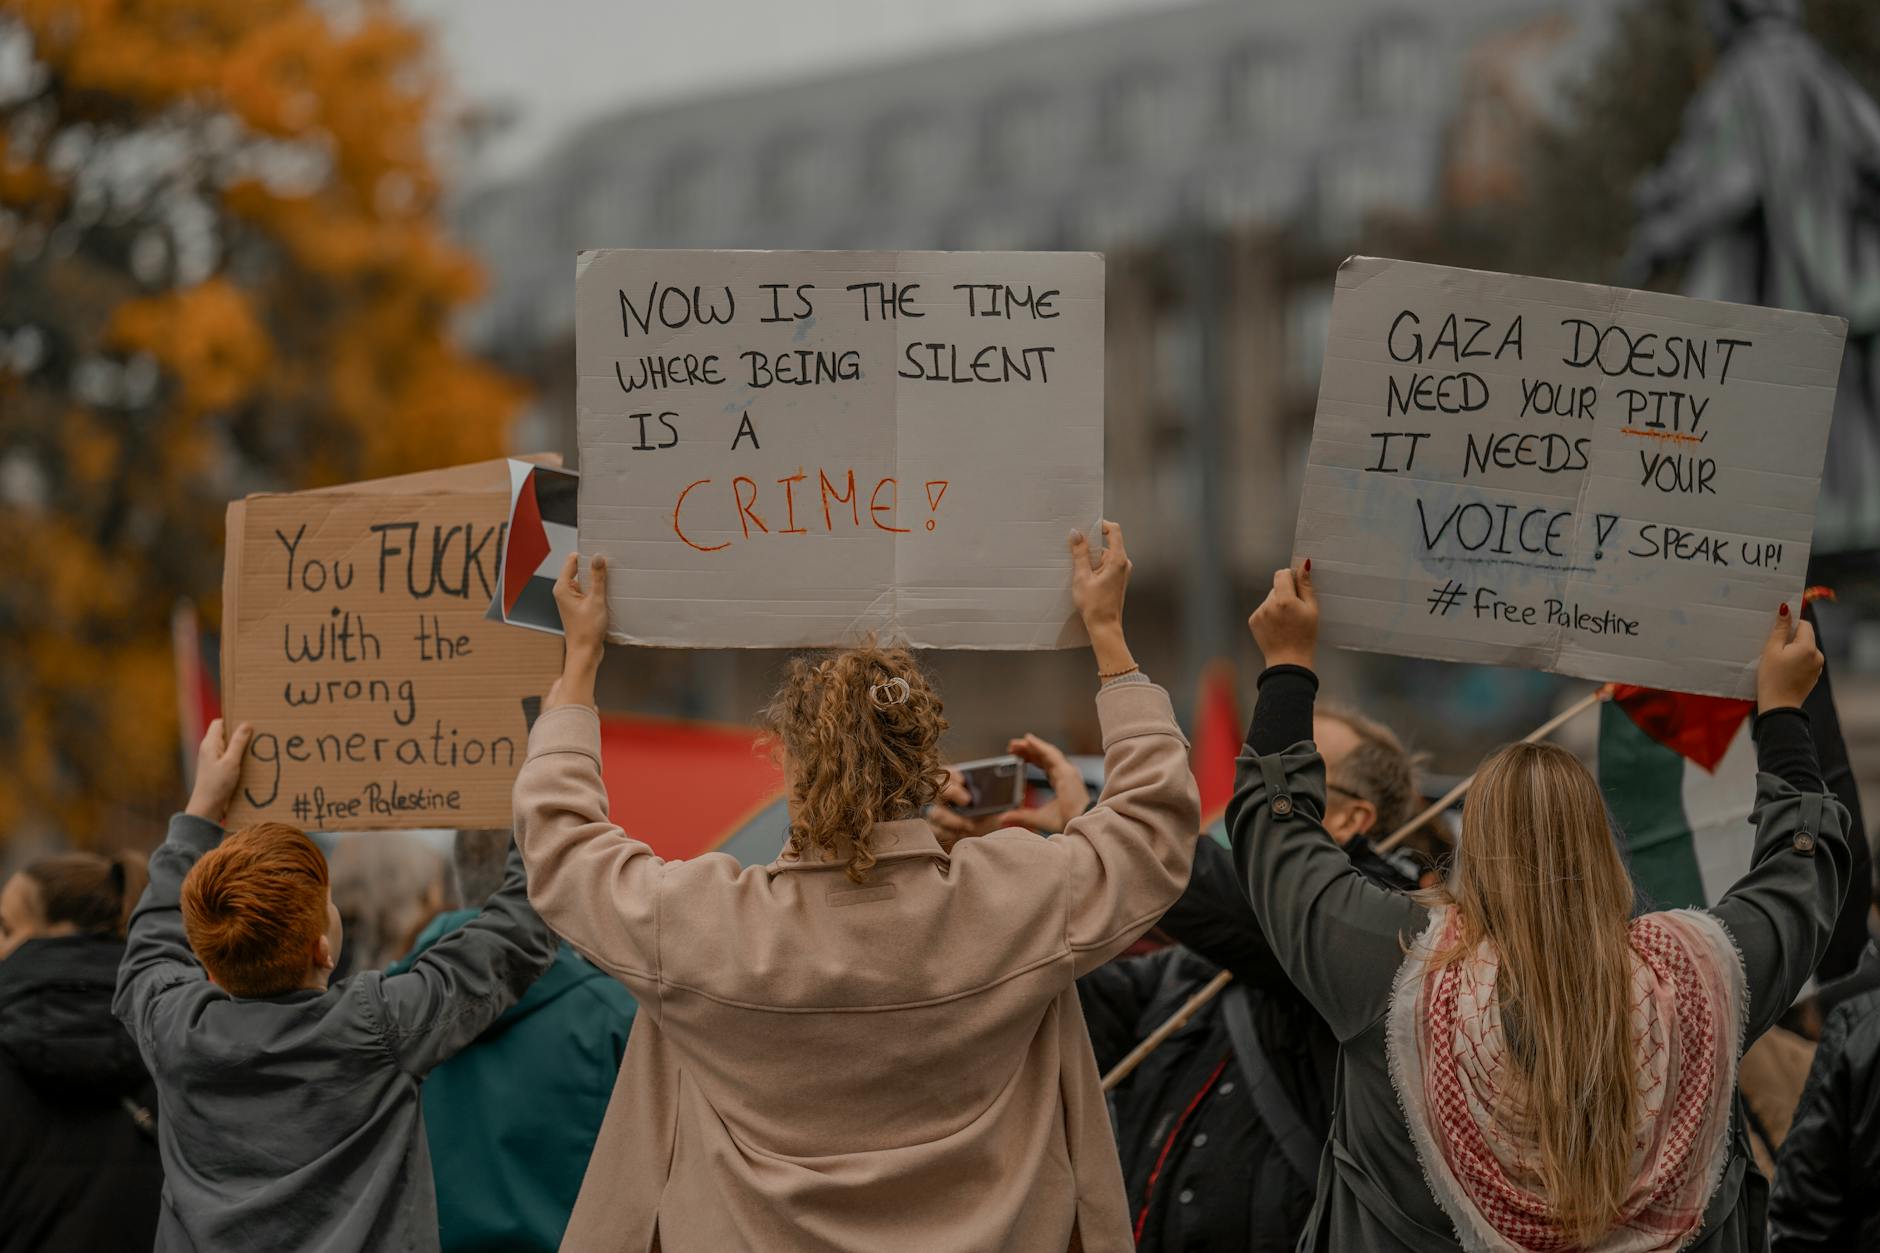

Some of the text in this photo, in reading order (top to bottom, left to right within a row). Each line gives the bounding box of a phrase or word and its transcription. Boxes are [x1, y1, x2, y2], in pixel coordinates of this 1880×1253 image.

[618, 281, 1061, 337] NOW IS THE TIME
[1388, 310, 1524, 364] GAZA
[615, 342, 1056, 393] WHERE BEING SILENT
[1387, 371, 1490, 418] NEED
[1520, 378, 1598, 420] YOUR
[629, 410, 761, 451] IS A
[1364, 432, 1717, 495] IT NEEDS YOUR
[1628, 524, 1729, 566] SPEAK
[1741, 541, 1783, 572] UP!
[283, 606, 473, 663] with the
[1544, 598, 1640, 636] Palestine
[283, 680, 416, 726] wrong
[243, 719, 514, 809] generation
